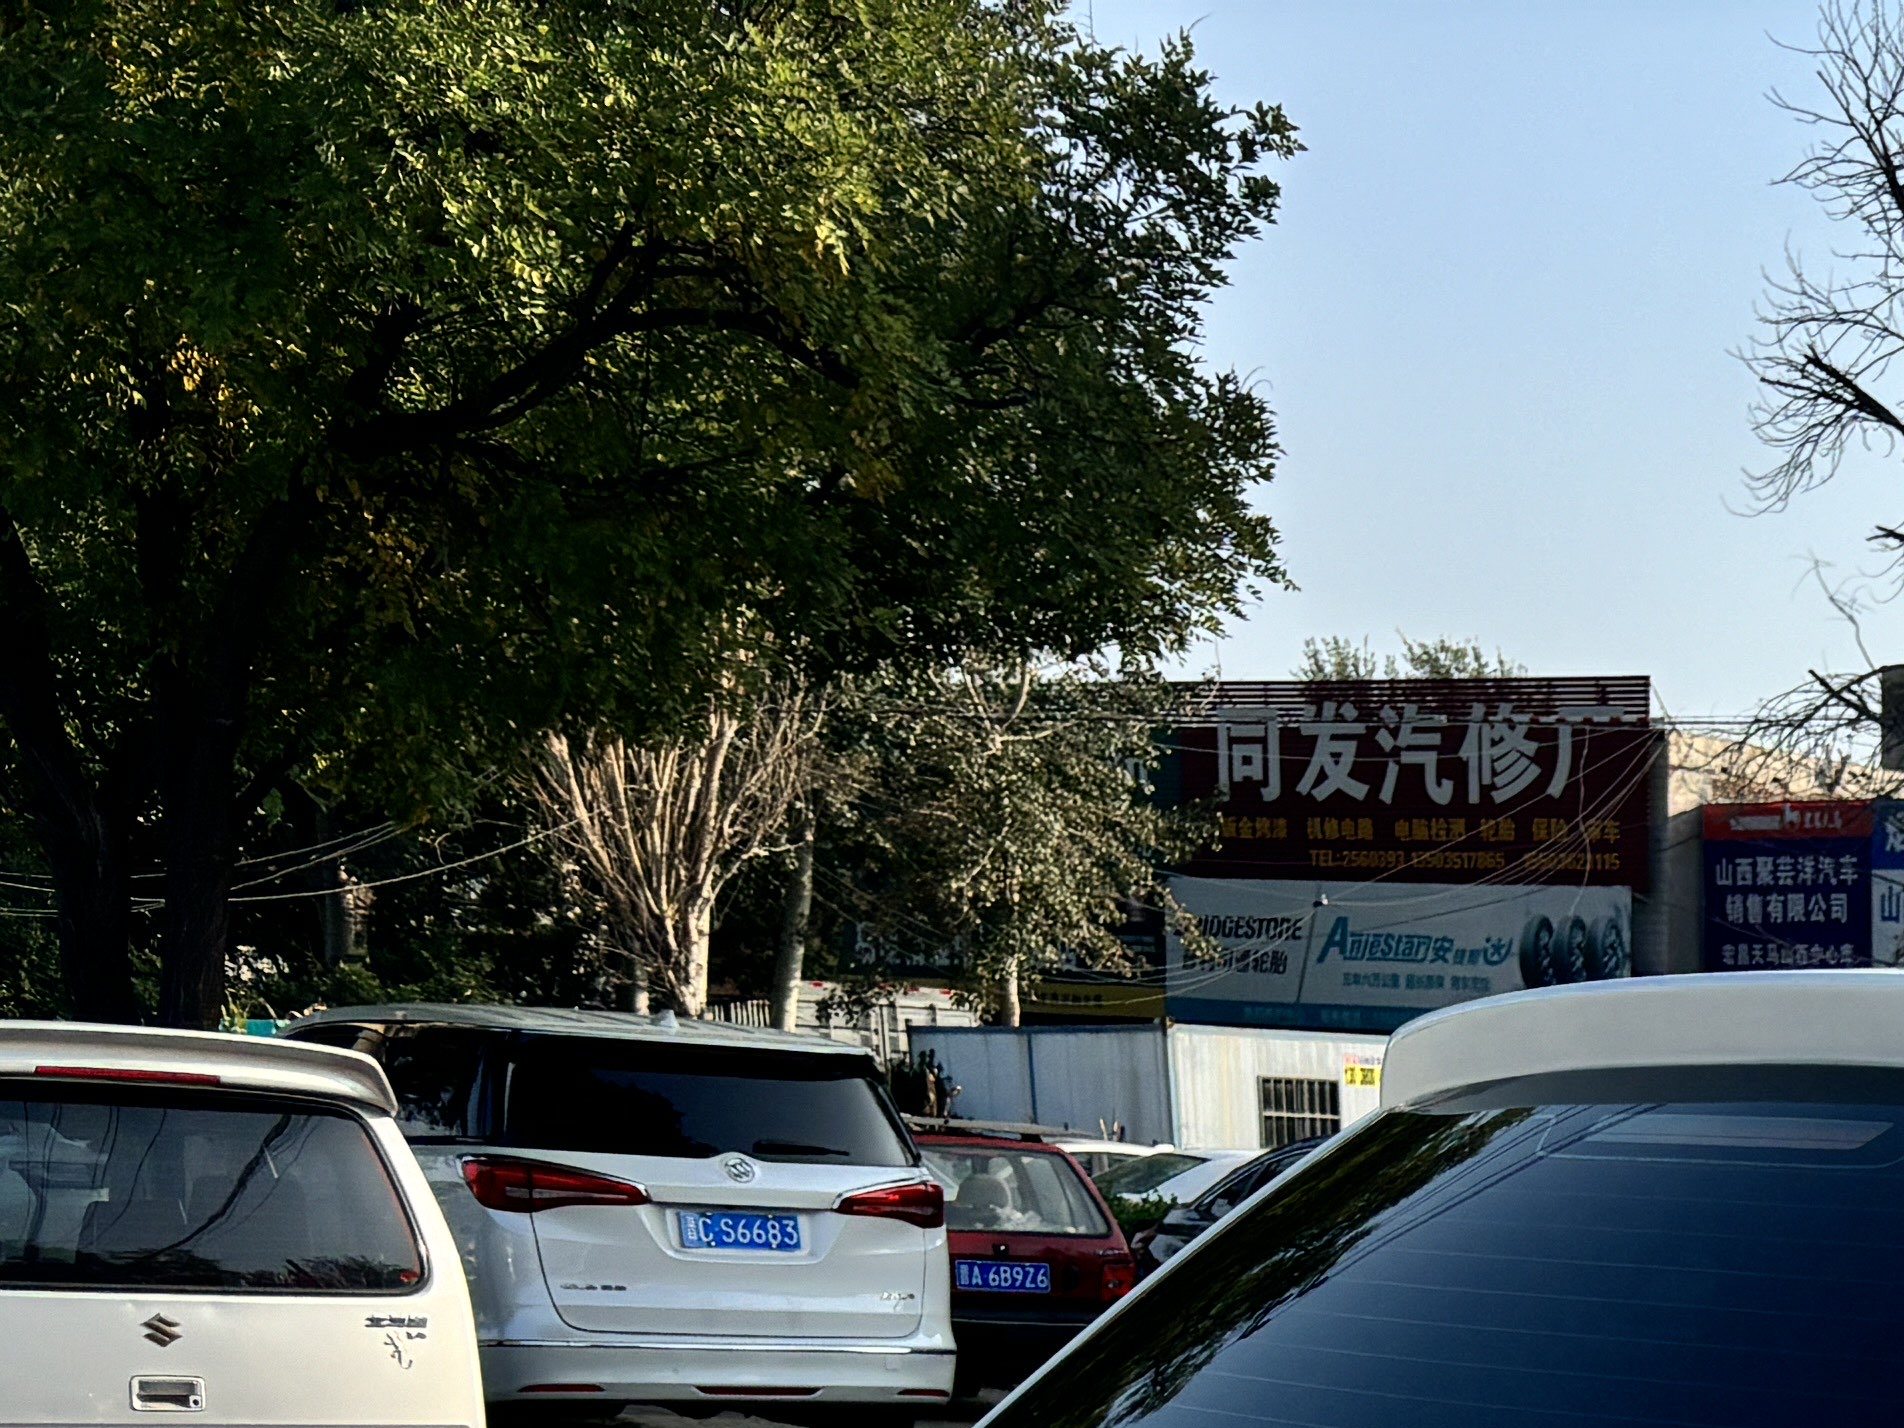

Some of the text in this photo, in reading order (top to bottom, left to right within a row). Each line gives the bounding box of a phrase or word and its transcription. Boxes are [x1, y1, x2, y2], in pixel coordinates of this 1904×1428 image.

[1217, 701, 1625, 804] 同发汽修厂
[1726, 892, 1847, 924] 销售有限公司
